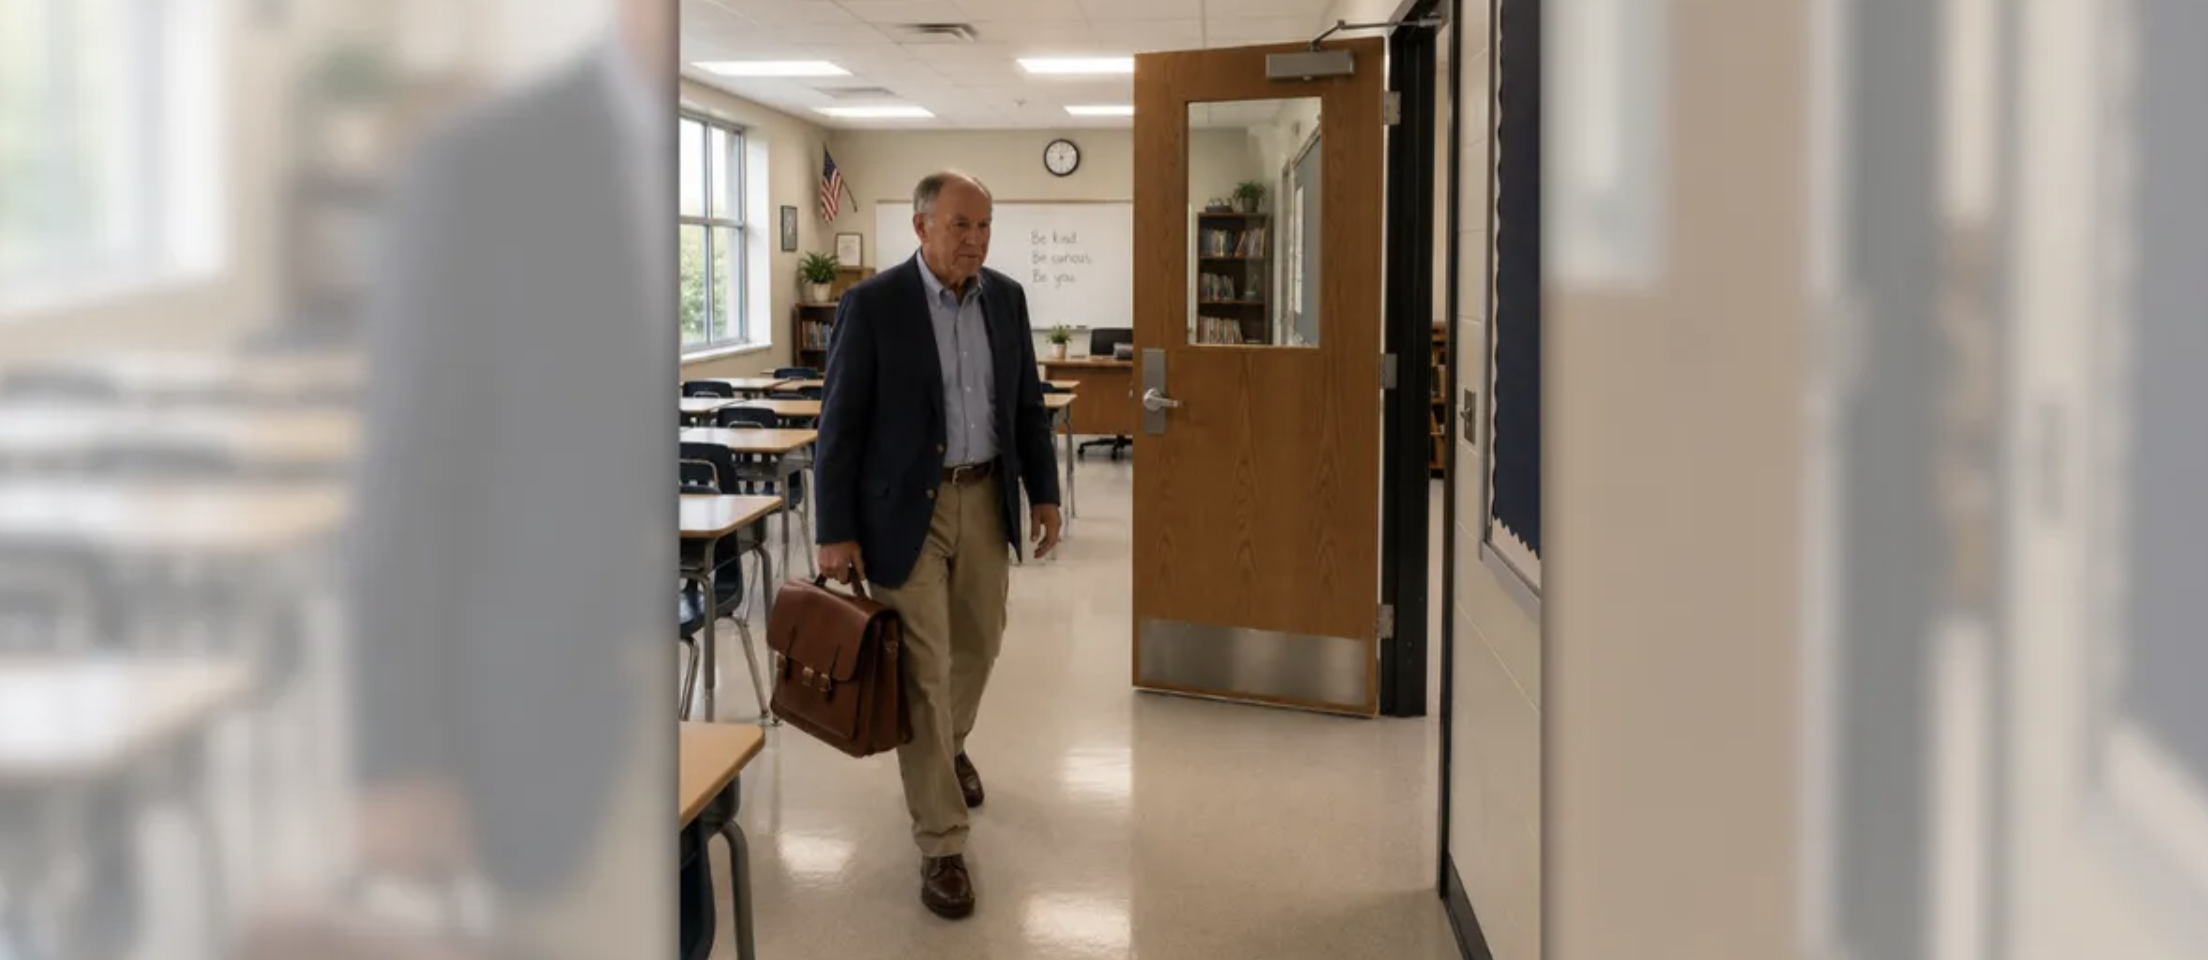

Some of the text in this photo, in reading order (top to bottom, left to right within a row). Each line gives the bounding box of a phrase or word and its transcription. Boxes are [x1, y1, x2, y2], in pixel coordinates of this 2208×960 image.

[1031, 230, 1047, 245] Be
[1031, 250, 1047, 265] Be
[1031, 269, 1047, 283] Be
